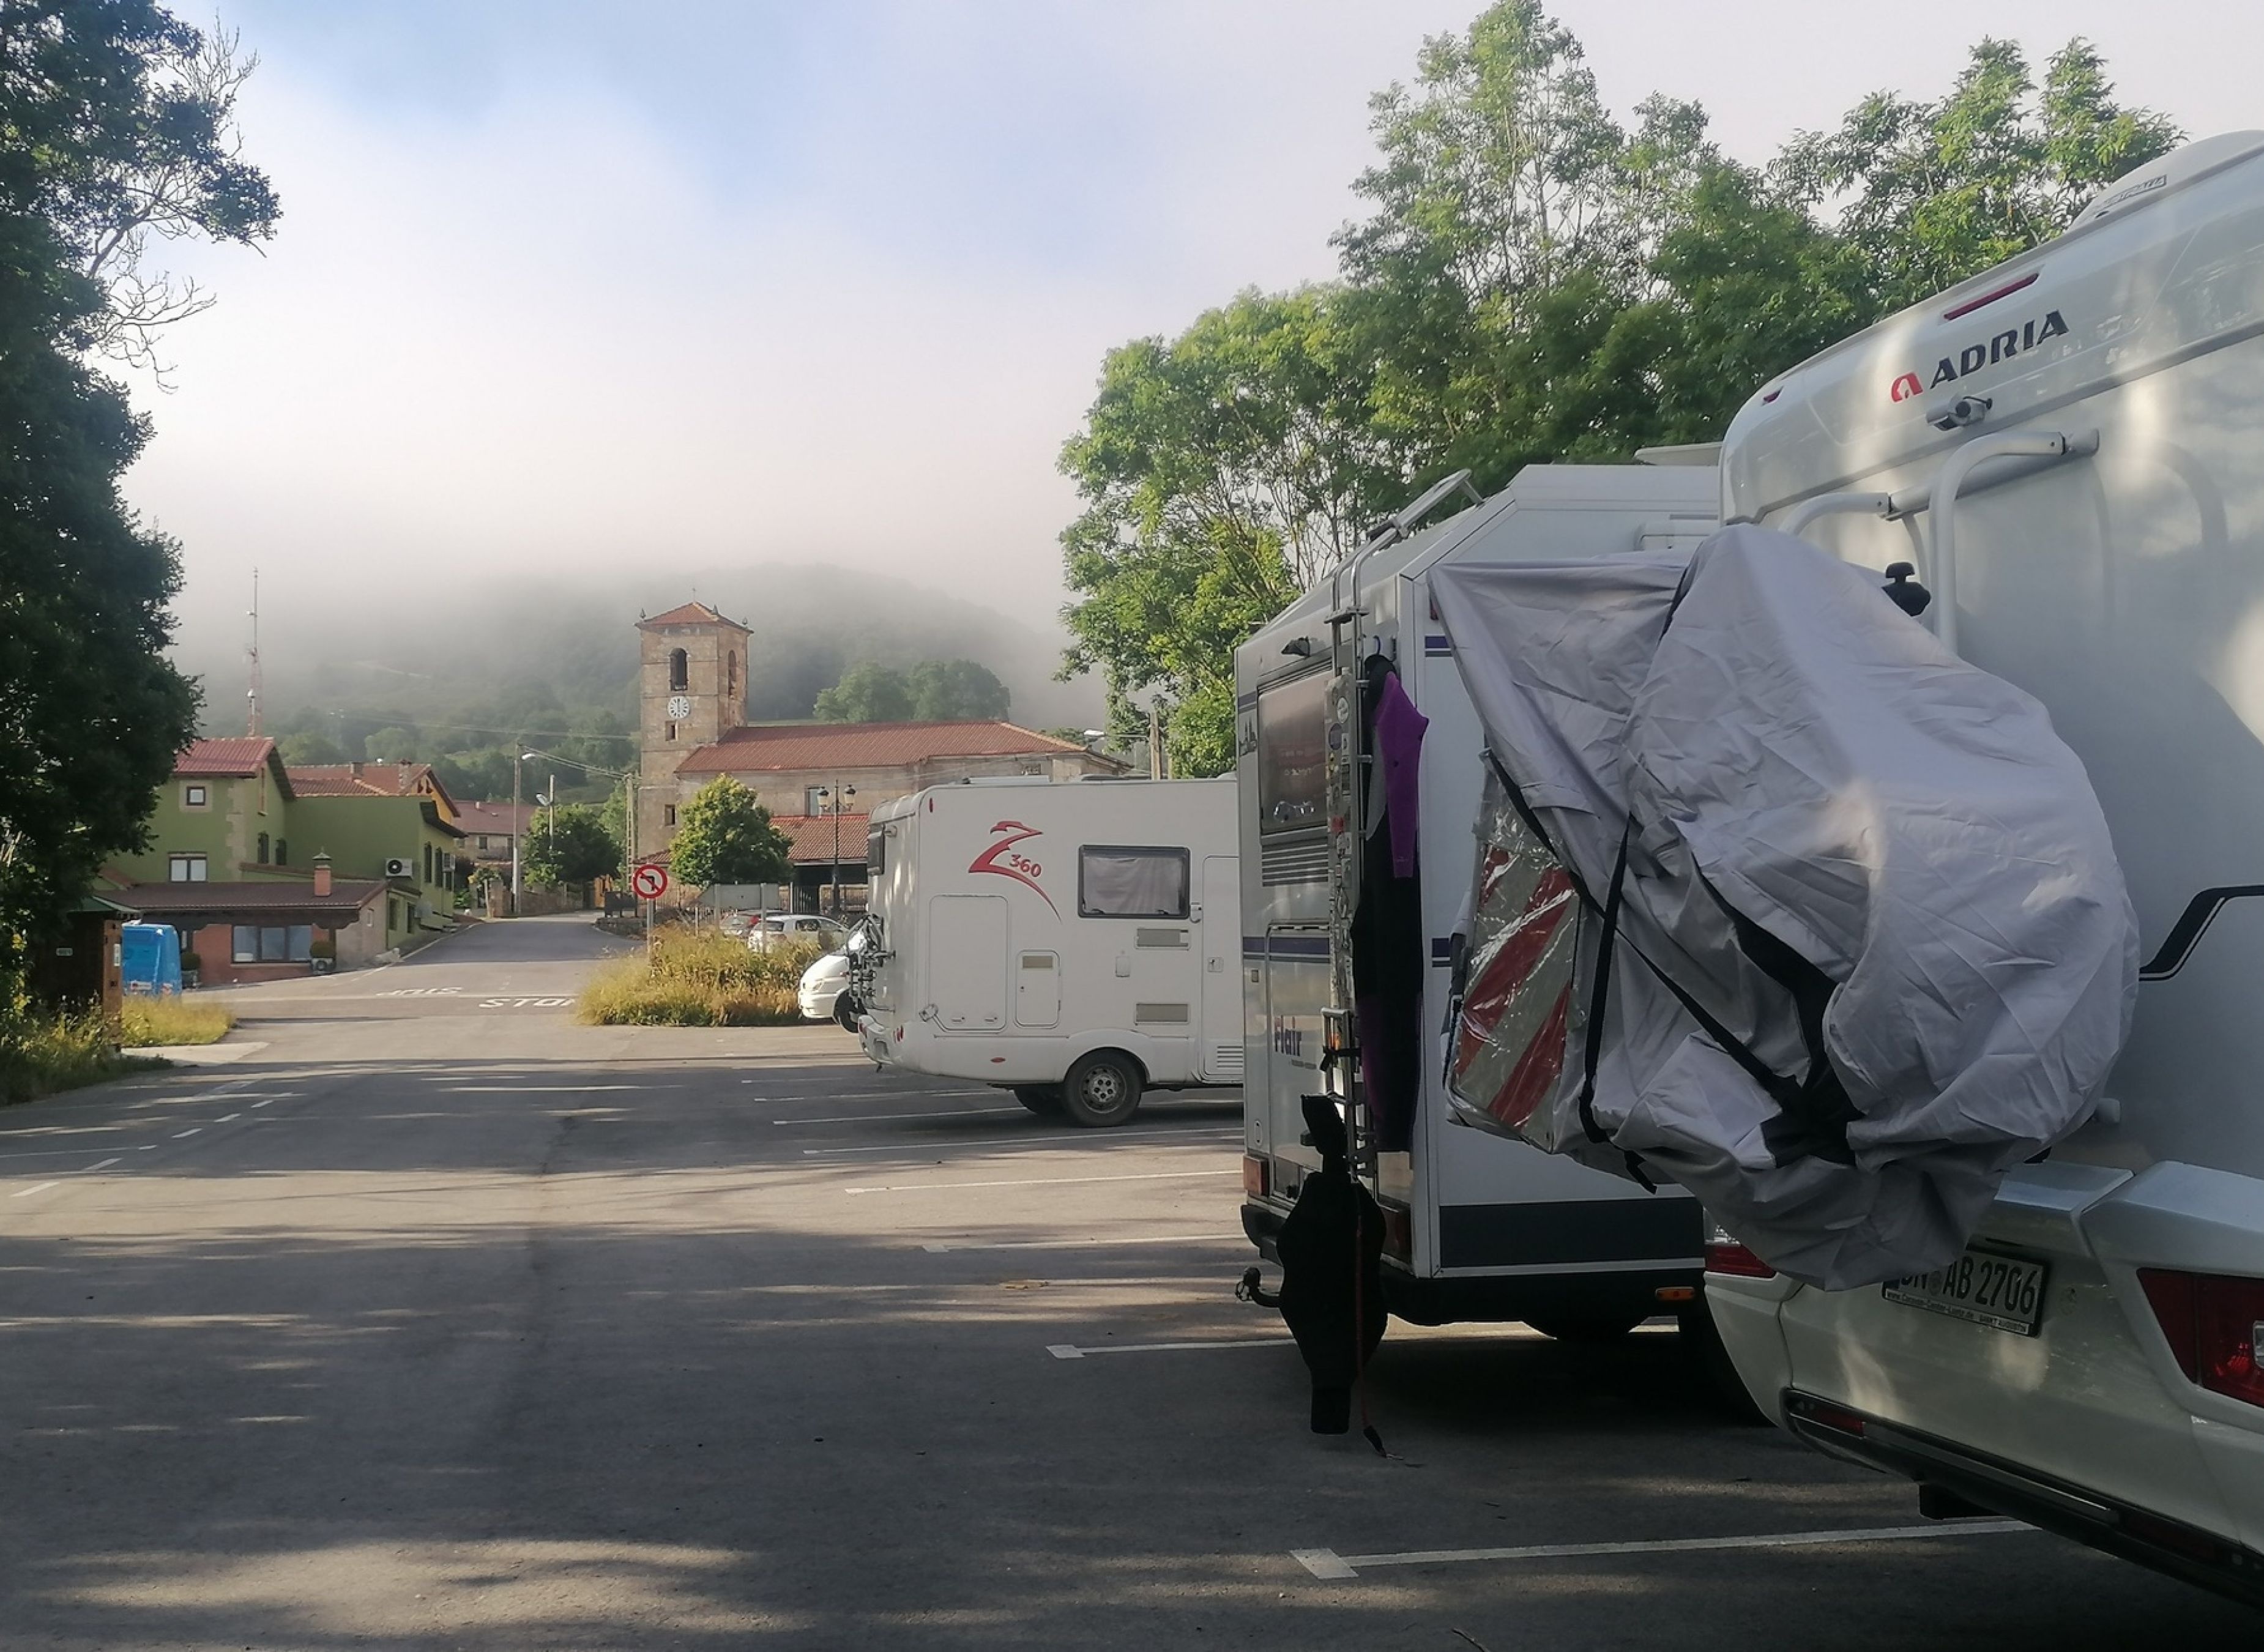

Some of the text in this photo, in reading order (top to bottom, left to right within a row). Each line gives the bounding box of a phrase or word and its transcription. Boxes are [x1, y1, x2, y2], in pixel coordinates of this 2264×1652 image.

[1930, 309, 2069, 390] ADRIA
[1009, 854, 1042, 877] 360
[1942, 1256, 2038, 1315] AB 2706
